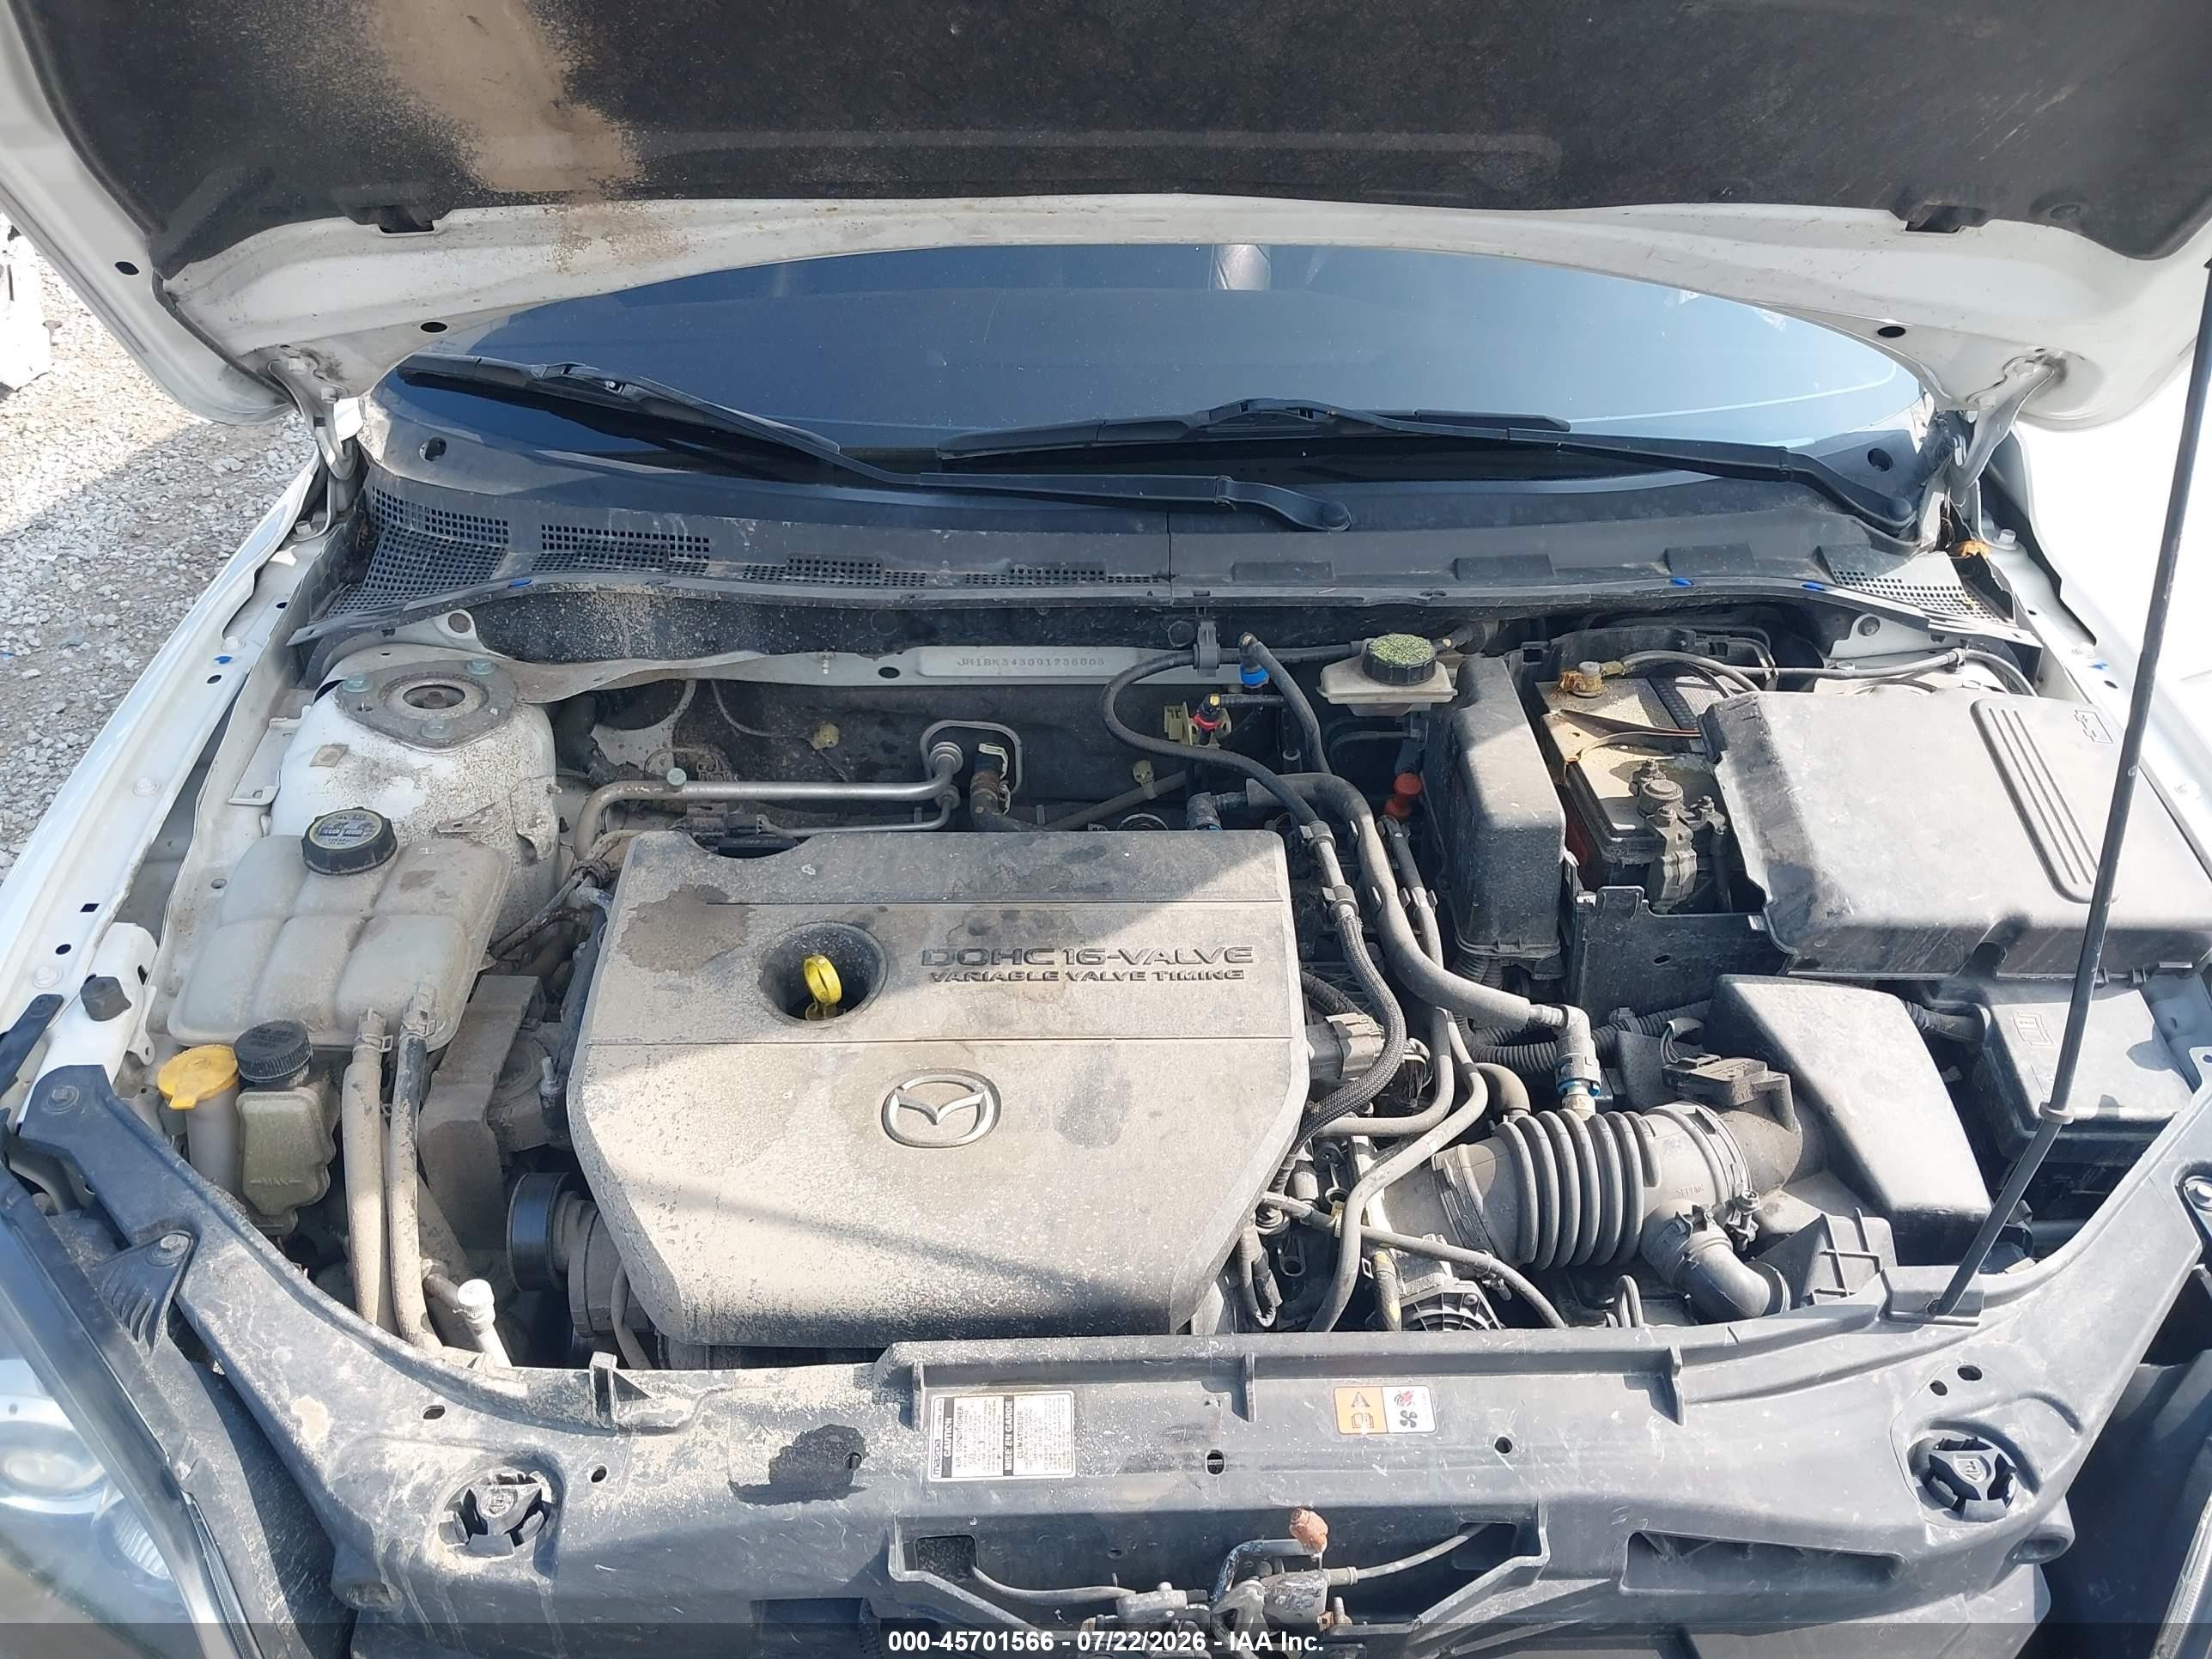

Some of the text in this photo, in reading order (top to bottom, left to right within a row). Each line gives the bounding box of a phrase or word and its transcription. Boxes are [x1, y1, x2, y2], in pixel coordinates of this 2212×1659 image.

[921, 946, 1255, 966] DOHC 16-VALVE
[929, 969, 1245, 982] VARIABLE VALVE TIMING
[1005, 1401, 1013, 1432] GARDE
[943, 1418, 953, 1457] CAUTION
[1005, 1433, 1013, 1444] EN
